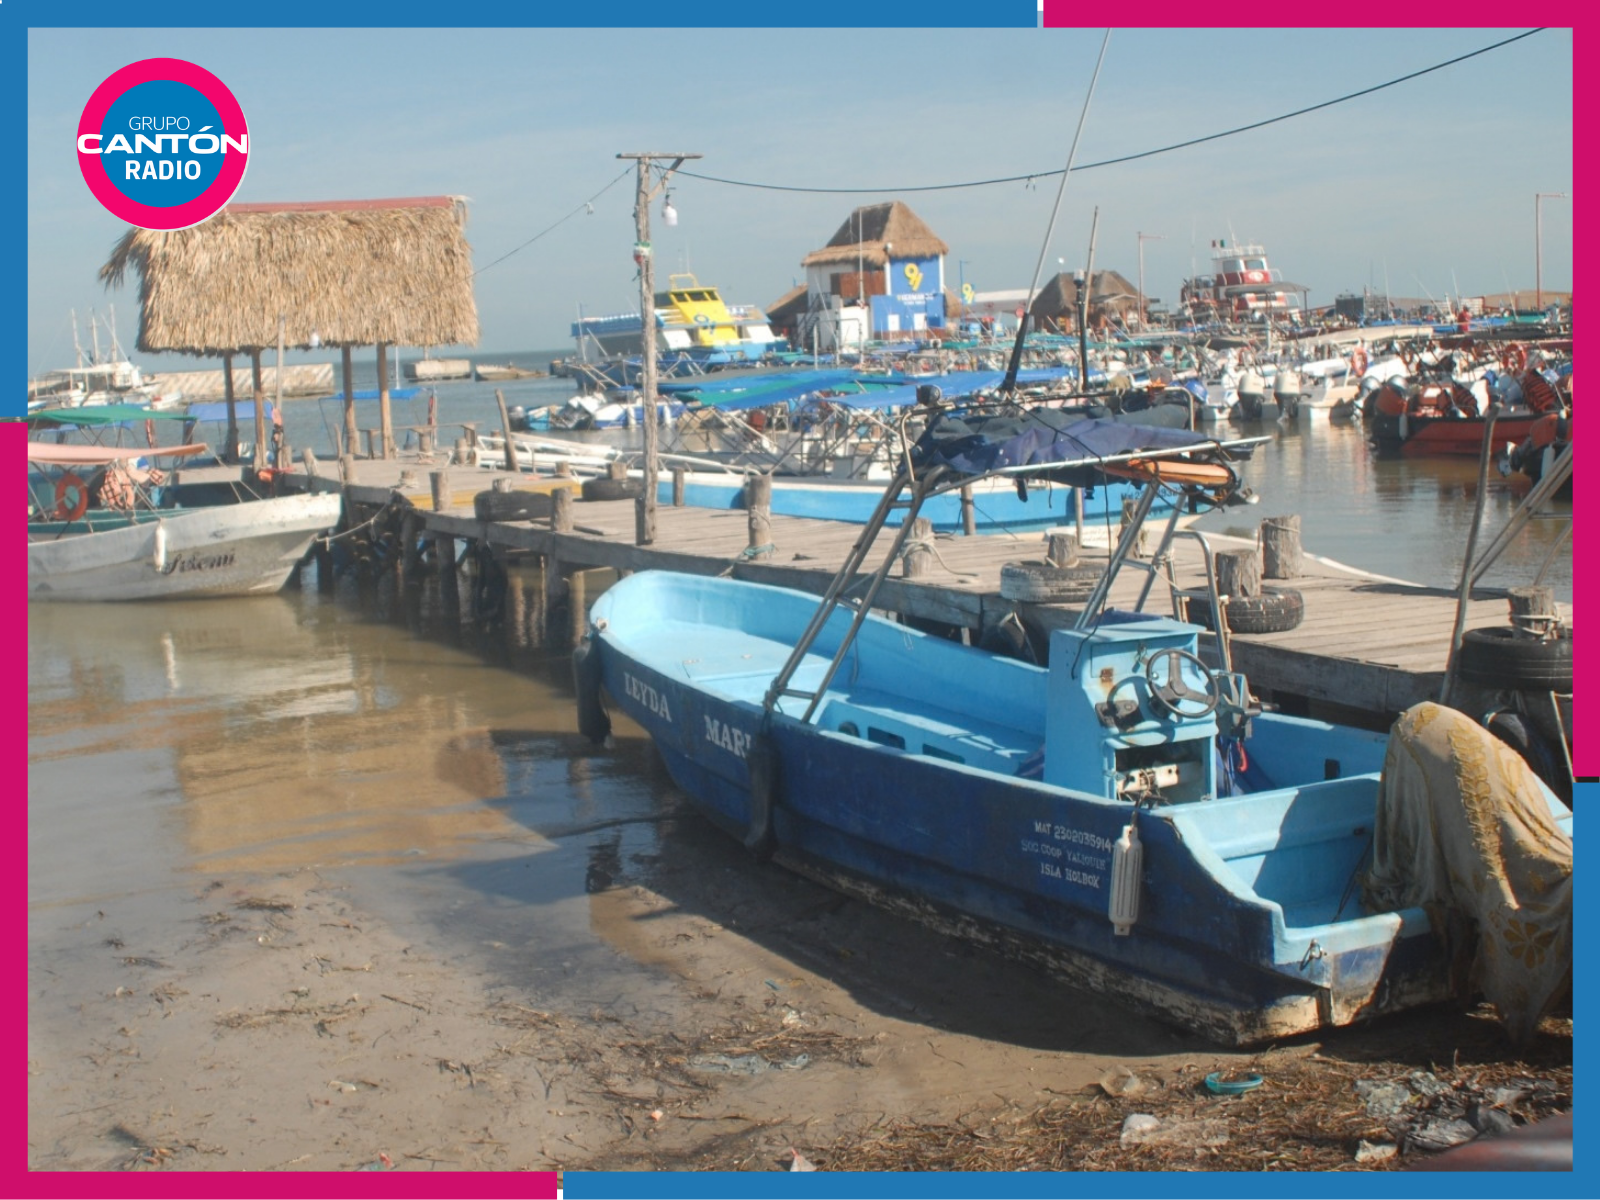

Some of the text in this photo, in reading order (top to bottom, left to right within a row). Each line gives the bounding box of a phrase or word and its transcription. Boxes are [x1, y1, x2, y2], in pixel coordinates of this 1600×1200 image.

[624, 672, 673, 723] LEYDA
[1034, 820, 1052, 836] MAT
[1040, 862, 1101, 889] ISLA HOLBOX
